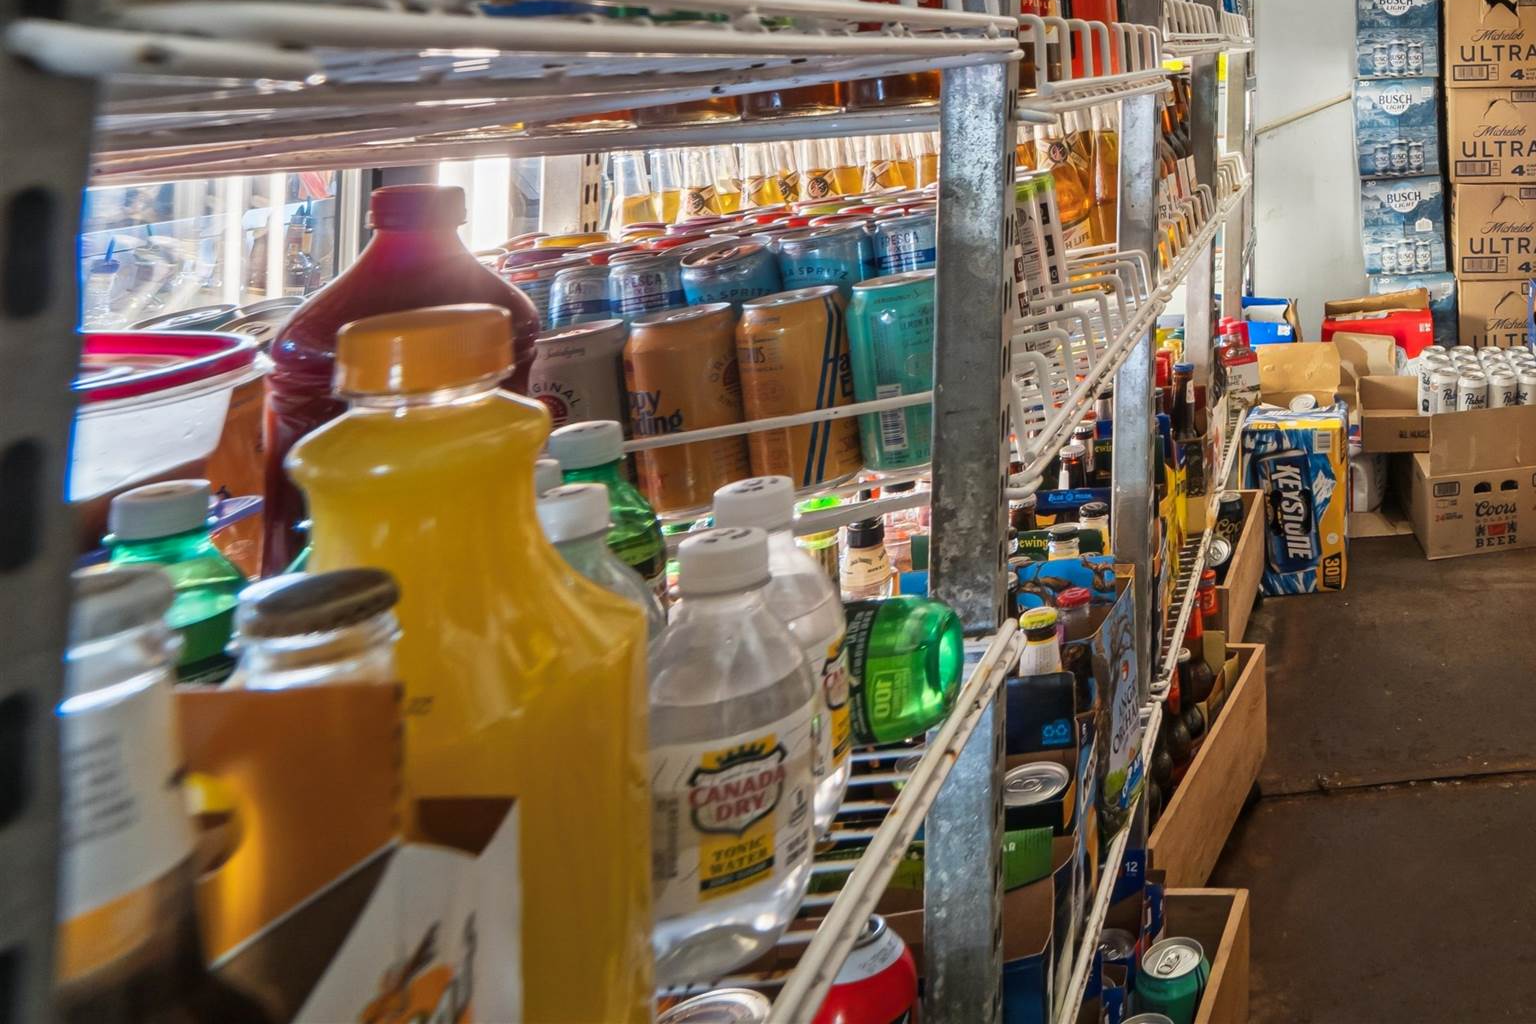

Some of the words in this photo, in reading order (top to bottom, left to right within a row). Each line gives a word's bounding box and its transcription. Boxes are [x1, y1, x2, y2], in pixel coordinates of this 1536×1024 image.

[1471, 28, 1525, 42] Michelob
[1510, 68, 1526, 81] 4
[1379, 94, 1413, 105] BUSCH
[1386, 103, 1407, 111] LIGHT
[1473, 124, 1528, 138] Michelob
[1511, 164, 1526, 176] 4
[1386, 191, 1421, 203] BUSCH
[1480, 221, 1535, 235] Michelob
[798, 266, 849, 280] SPRITZ
[1517, 261, 1533, 273] 4
[1272, 464, 1313, 560] KEYSTONE
[1474, 500, 1518, 518] Coors
[1474, 535, 1518, 550] BEER
[1325, 558, 1341, 576] 30
[873, 678, 893, 719] 100
[688, 763, 787, 811] CANADA
[714, 792, 766, 824] DRY
[713, 836, 764, 862] TONIC
[709, 847, 769, 874] WATER
[1125, 860, 1139, 874] 12
